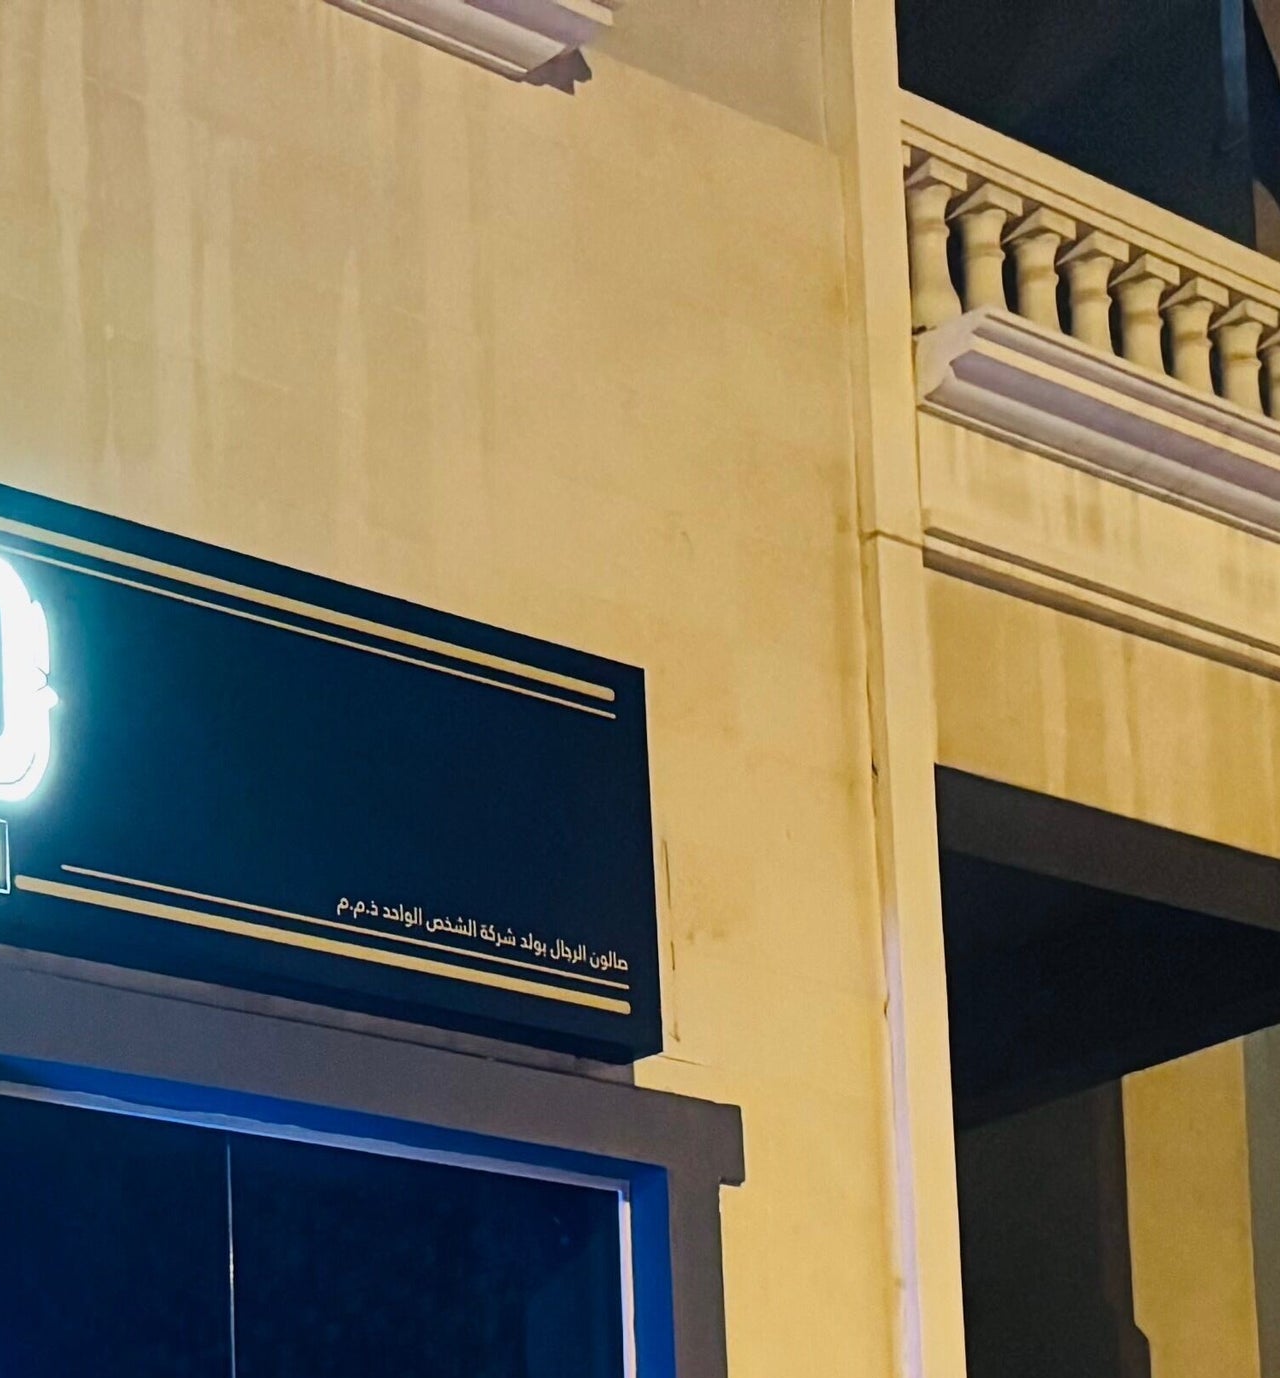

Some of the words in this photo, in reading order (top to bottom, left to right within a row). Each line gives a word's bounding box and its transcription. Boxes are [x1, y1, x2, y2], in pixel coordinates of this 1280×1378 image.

[382, 903, 423, 928] الواحد
[425, 915, 478, 938] الشخص
[479, 923, 517, 948] شركة
[519, 931, 547, 958] بولد
[549, 938, 587, 964] الرجال
[589, 950, 629, 971] صالون
